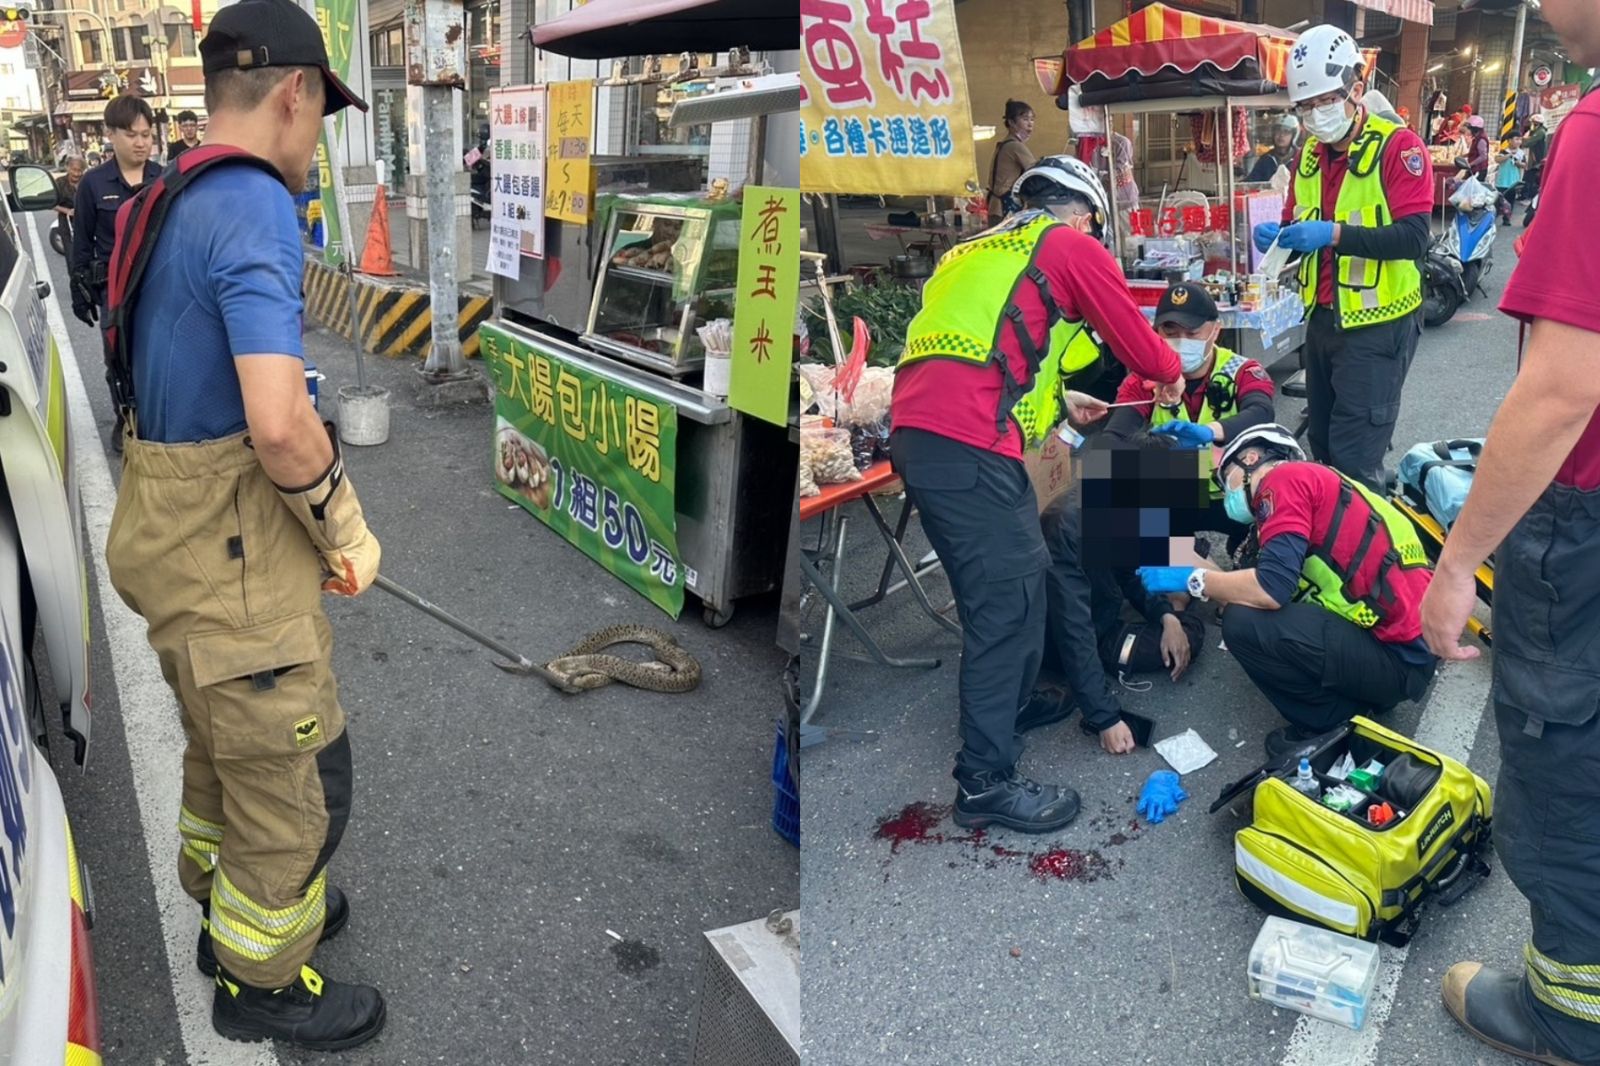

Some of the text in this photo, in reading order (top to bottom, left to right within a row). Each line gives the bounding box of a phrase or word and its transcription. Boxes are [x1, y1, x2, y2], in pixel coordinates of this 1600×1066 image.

[750, 195, 788, 364] 煮玉米
[502, 341, 661, 482] 大腸包小腸
[551, 456, 678, 586] 1組50元
